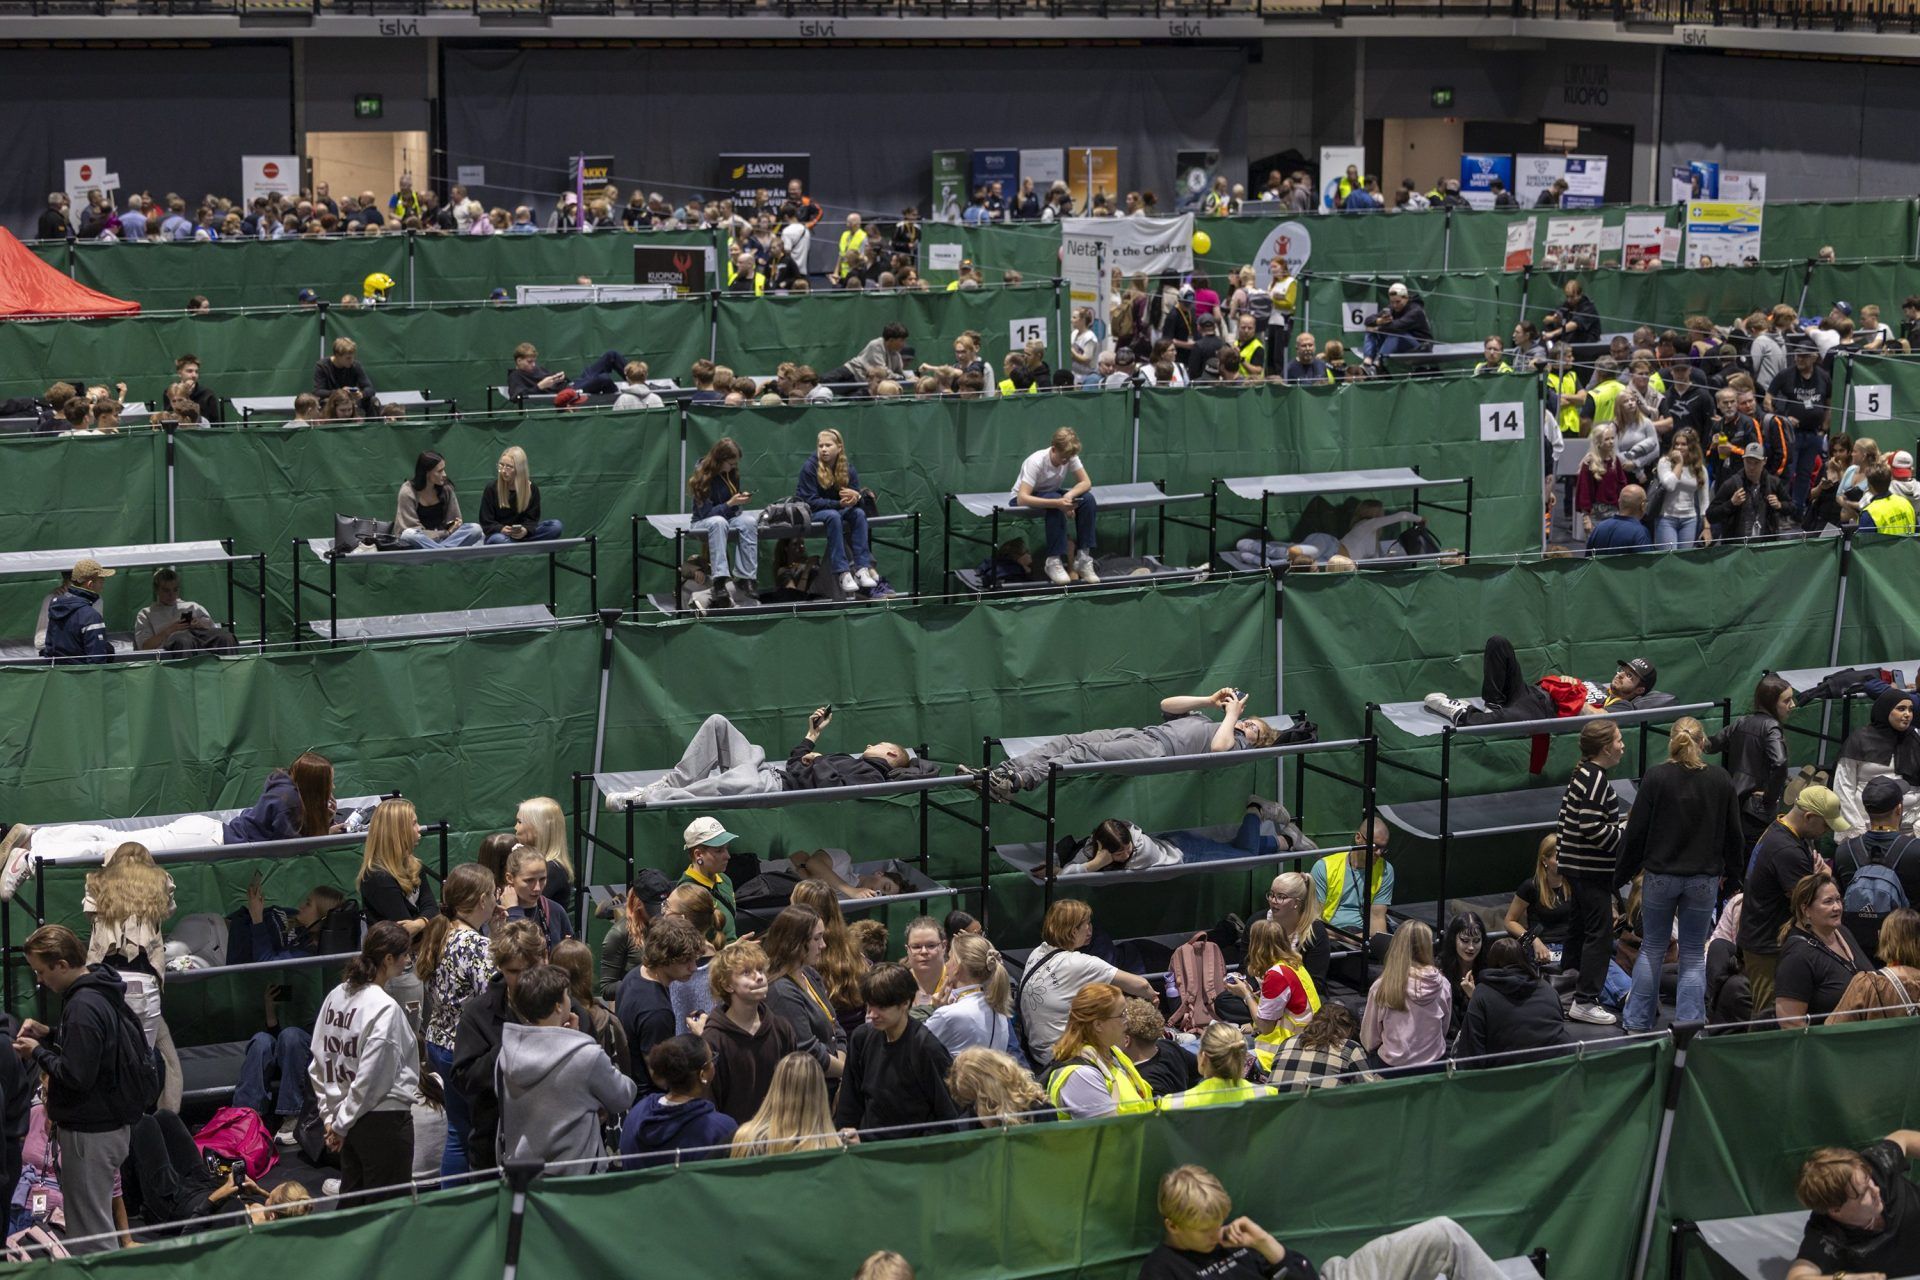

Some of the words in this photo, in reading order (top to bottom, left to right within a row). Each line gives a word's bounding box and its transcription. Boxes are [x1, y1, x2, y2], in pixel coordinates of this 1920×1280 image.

[1564, 86, 1608, 106] KUOPIO
[581, 166, 608, 178] AKKY
[746, 163, 784, 174] SAVON
[739, 188, 787, 198] KESVÄN
[1122, 246, 1140, 256] the
[1143, 244, 1187, 256] Children
[1351, 309, 1364, 325] 6
[1016, 325, 1040, 342] 15
[1868, 393, 1879, 413] 5
[1489, 411, 1518, 432] 14
[325, 1001, 357, 1030] bad
